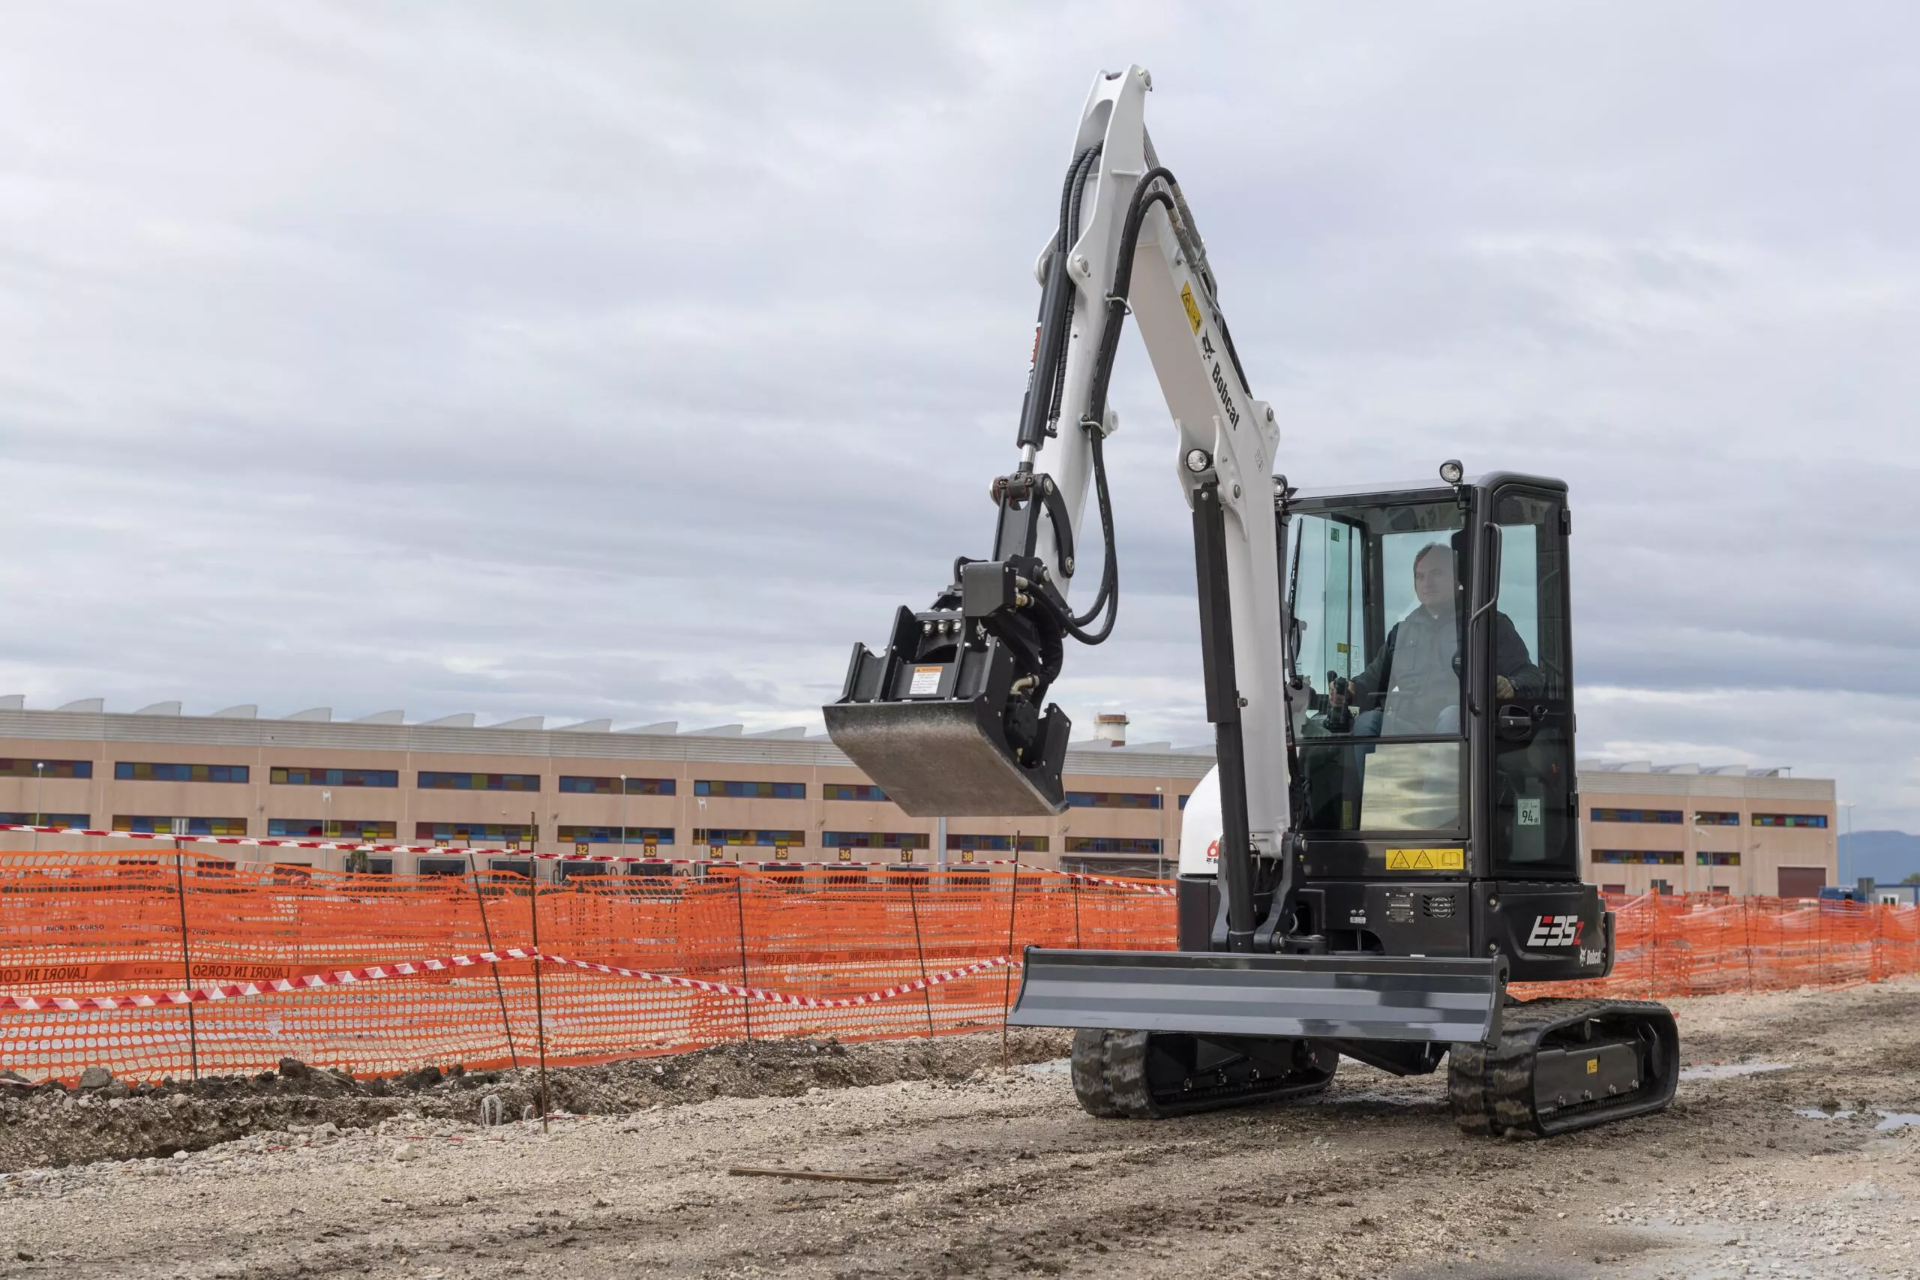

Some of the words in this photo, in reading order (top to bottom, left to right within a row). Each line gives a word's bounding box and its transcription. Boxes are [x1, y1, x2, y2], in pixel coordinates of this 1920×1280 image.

[1211, 361, 1240, 431] Bobcat
[1522, 810, 1533, 823] 94
[576, 845, 588, 855] 32
[644, 846, 656, 856] 33
[710, 847, 722, 857] 34
[776, 848, 787, 858] 35
[839, 850, 850, 859] 36
[962, 851, 973, 861] 38
